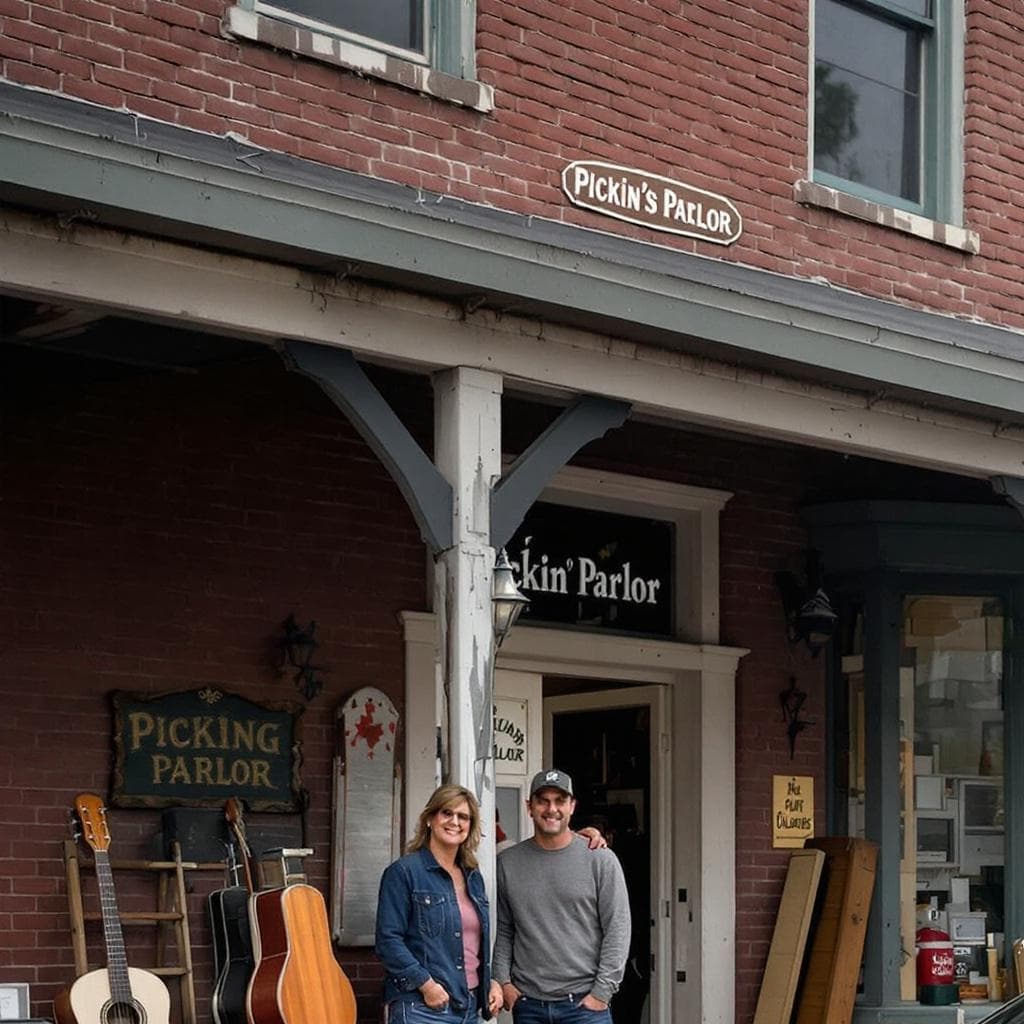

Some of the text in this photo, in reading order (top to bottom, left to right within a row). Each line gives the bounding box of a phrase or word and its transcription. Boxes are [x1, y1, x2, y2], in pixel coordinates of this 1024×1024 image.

[511, 547, 661, 605] ckin' Parlor
[128, 711, 283, 755] PICKING
[151, 755, 280, 790] PARLOR
